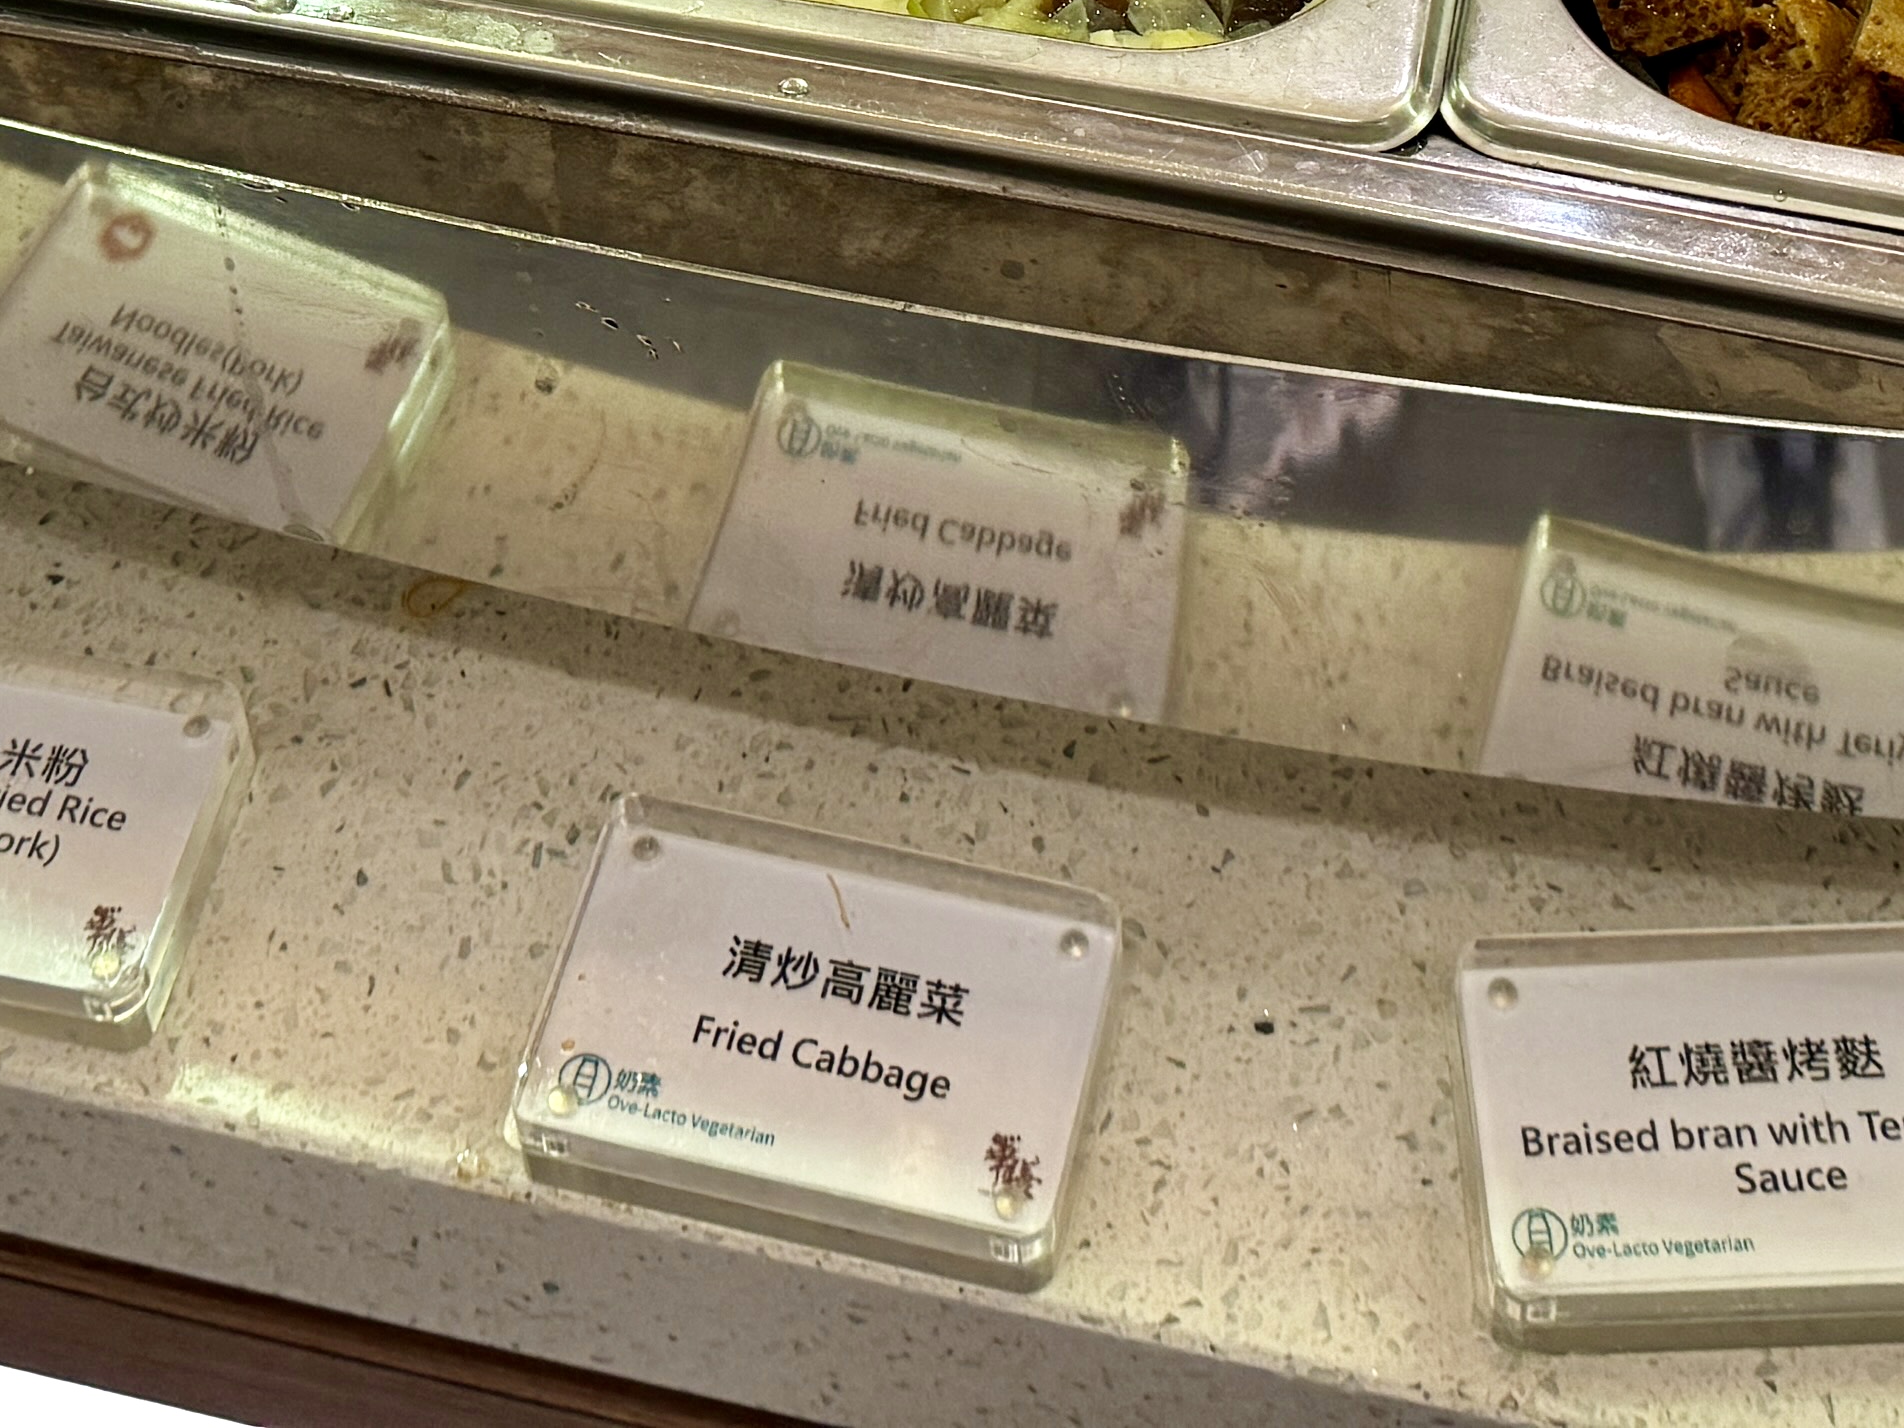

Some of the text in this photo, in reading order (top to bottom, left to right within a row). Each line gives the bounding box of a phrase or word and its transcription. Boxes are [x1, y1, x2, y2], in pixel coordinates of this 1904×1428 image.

[57, 793, 127, 832] Rice
[721, 934, 970, 1028] 清炒高麗菜
[691, 1013, 952, 1102] Fried Cabbage
[1628, 1033, 1887, 1090] 紅燒醬烤麩
[607, 1094, 776, 1148] Ove-Lacto Vegetarian
[1520, 1118, 1660, 1158] Braised
[1671, 1117, 1757, 1152] bran
[1767, 1110, 1851, 1148] with
[1734, 1162, 1848, 1195] Sauce
[1571, 1235, 1757, 1260] Ove-Lacto Vegetarian
